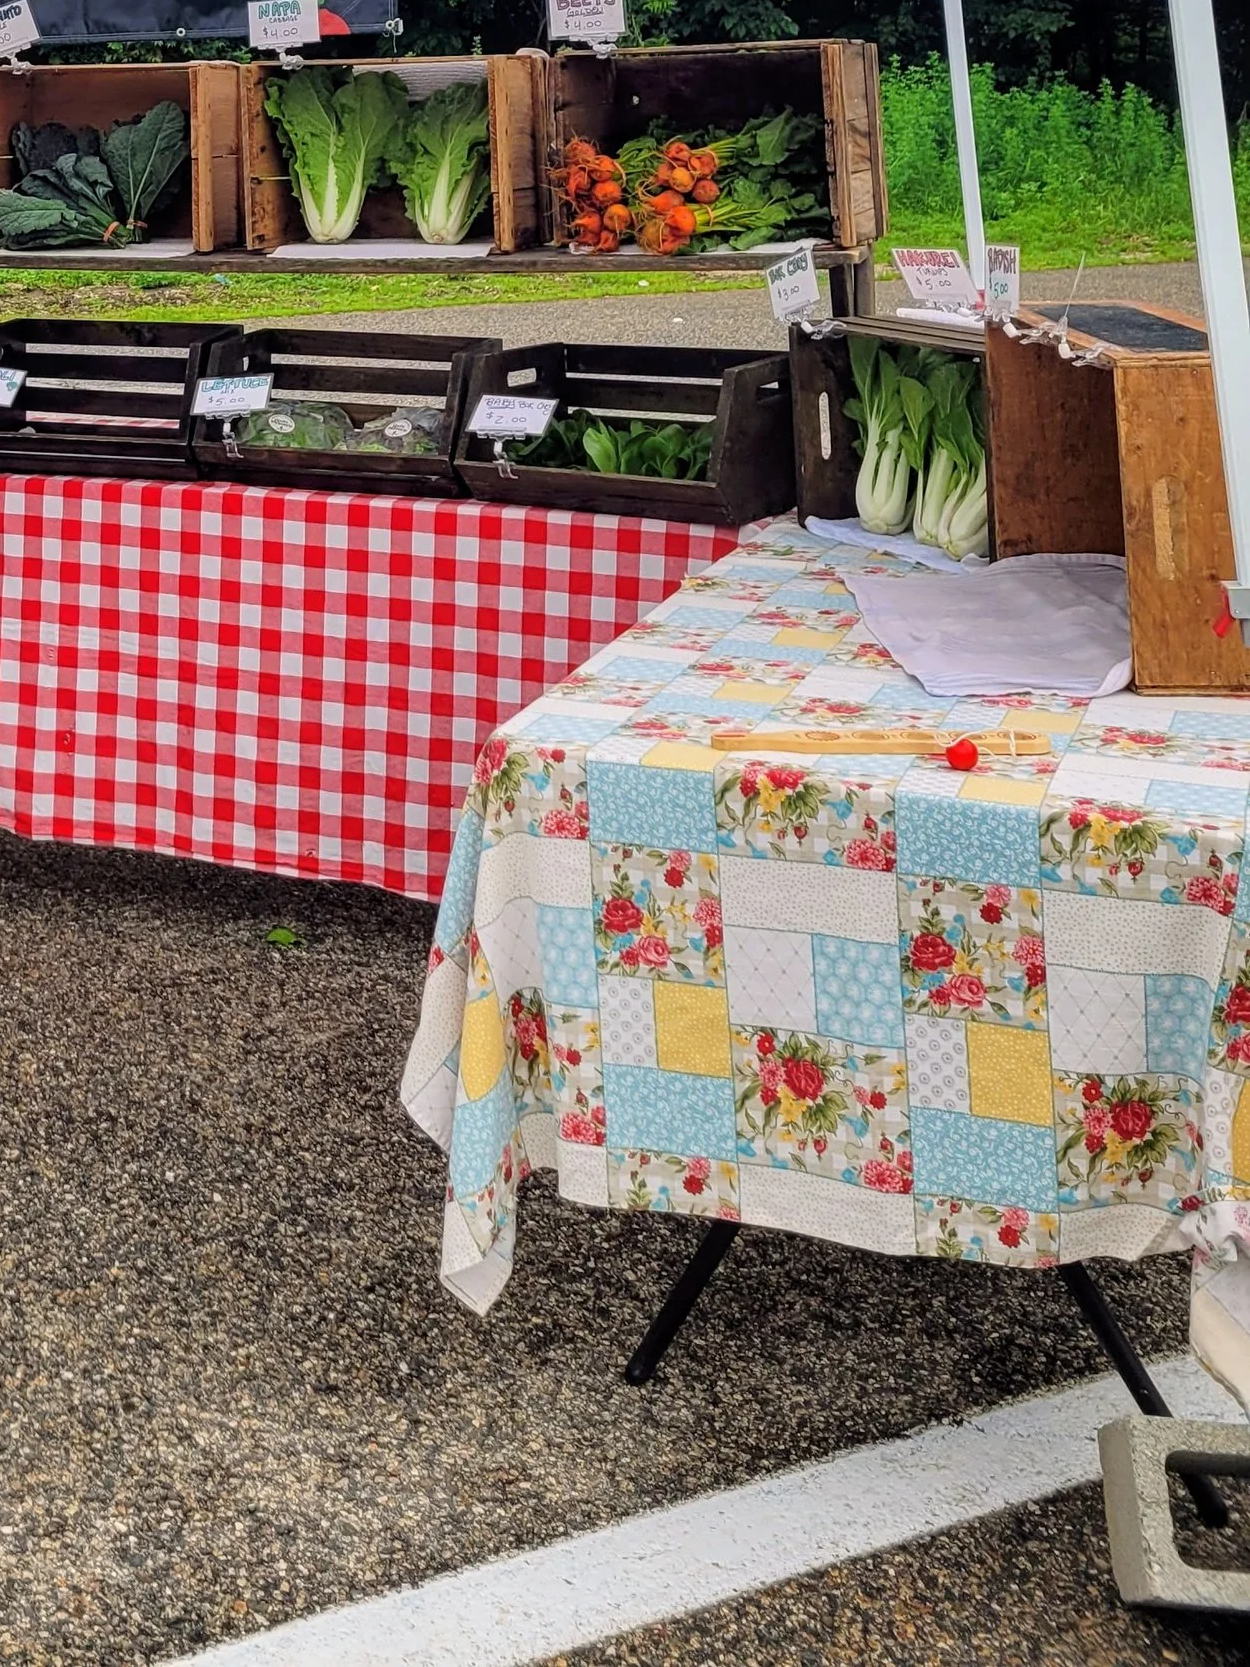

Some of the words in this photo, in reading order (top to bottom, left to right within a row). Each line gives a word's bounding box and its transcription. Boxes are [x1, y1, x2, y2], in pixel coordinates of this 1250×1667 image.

[258, 0, 302, 20] NAPA
[269, 15, 299, 24] CABBAGE
[201, 377, 269, 393] LETTUCE
